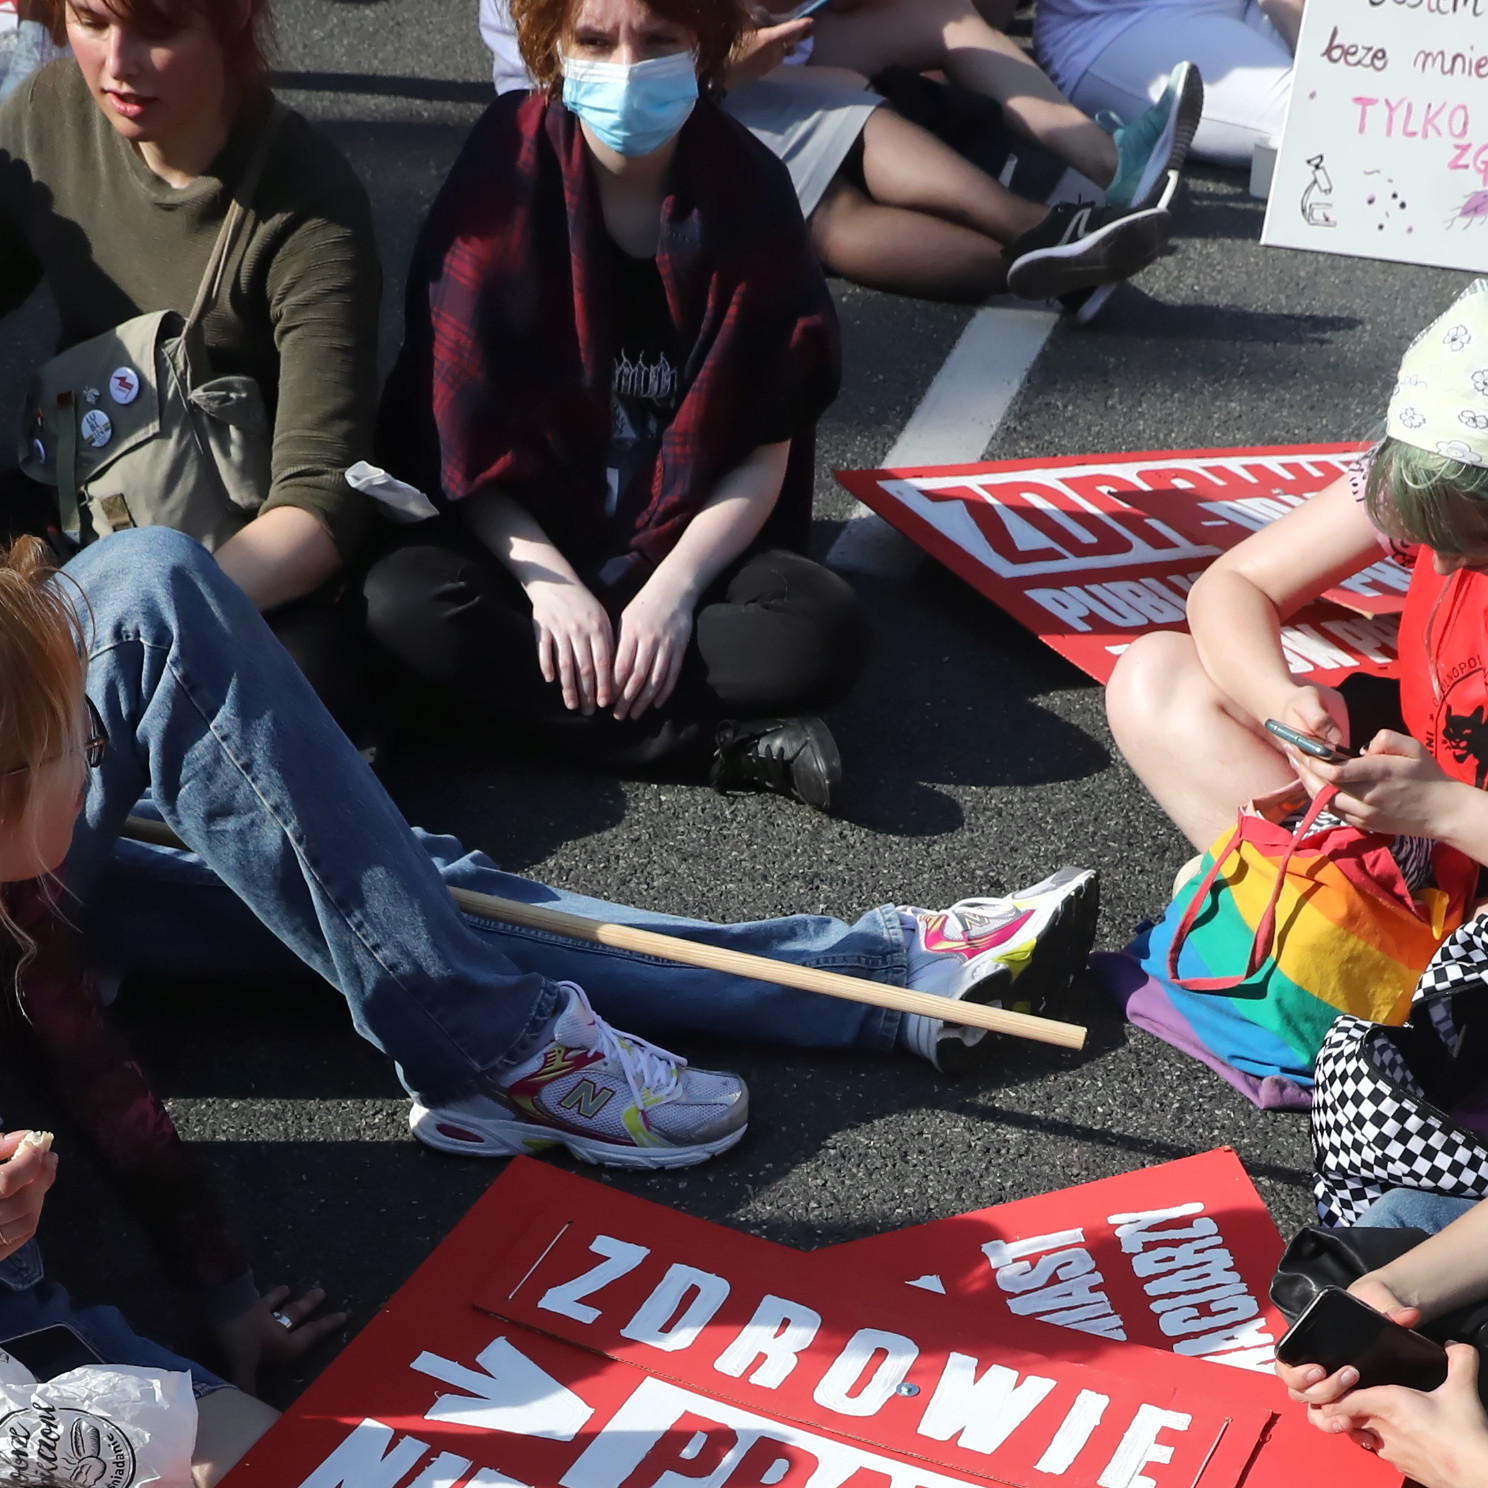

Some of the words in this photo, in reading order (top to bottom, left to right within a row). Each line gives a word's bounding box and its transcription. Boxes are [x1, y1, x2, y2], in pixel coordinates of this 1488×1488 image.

[1320, 25, 1389, 73] beze
[1352, 96, 1471, 140] TYLKO
[560, 1078, 616, 1119] N
[1107, 1202, 1277, 1376] ACIARZY
[0, 1422, 31, 1481] obrze
